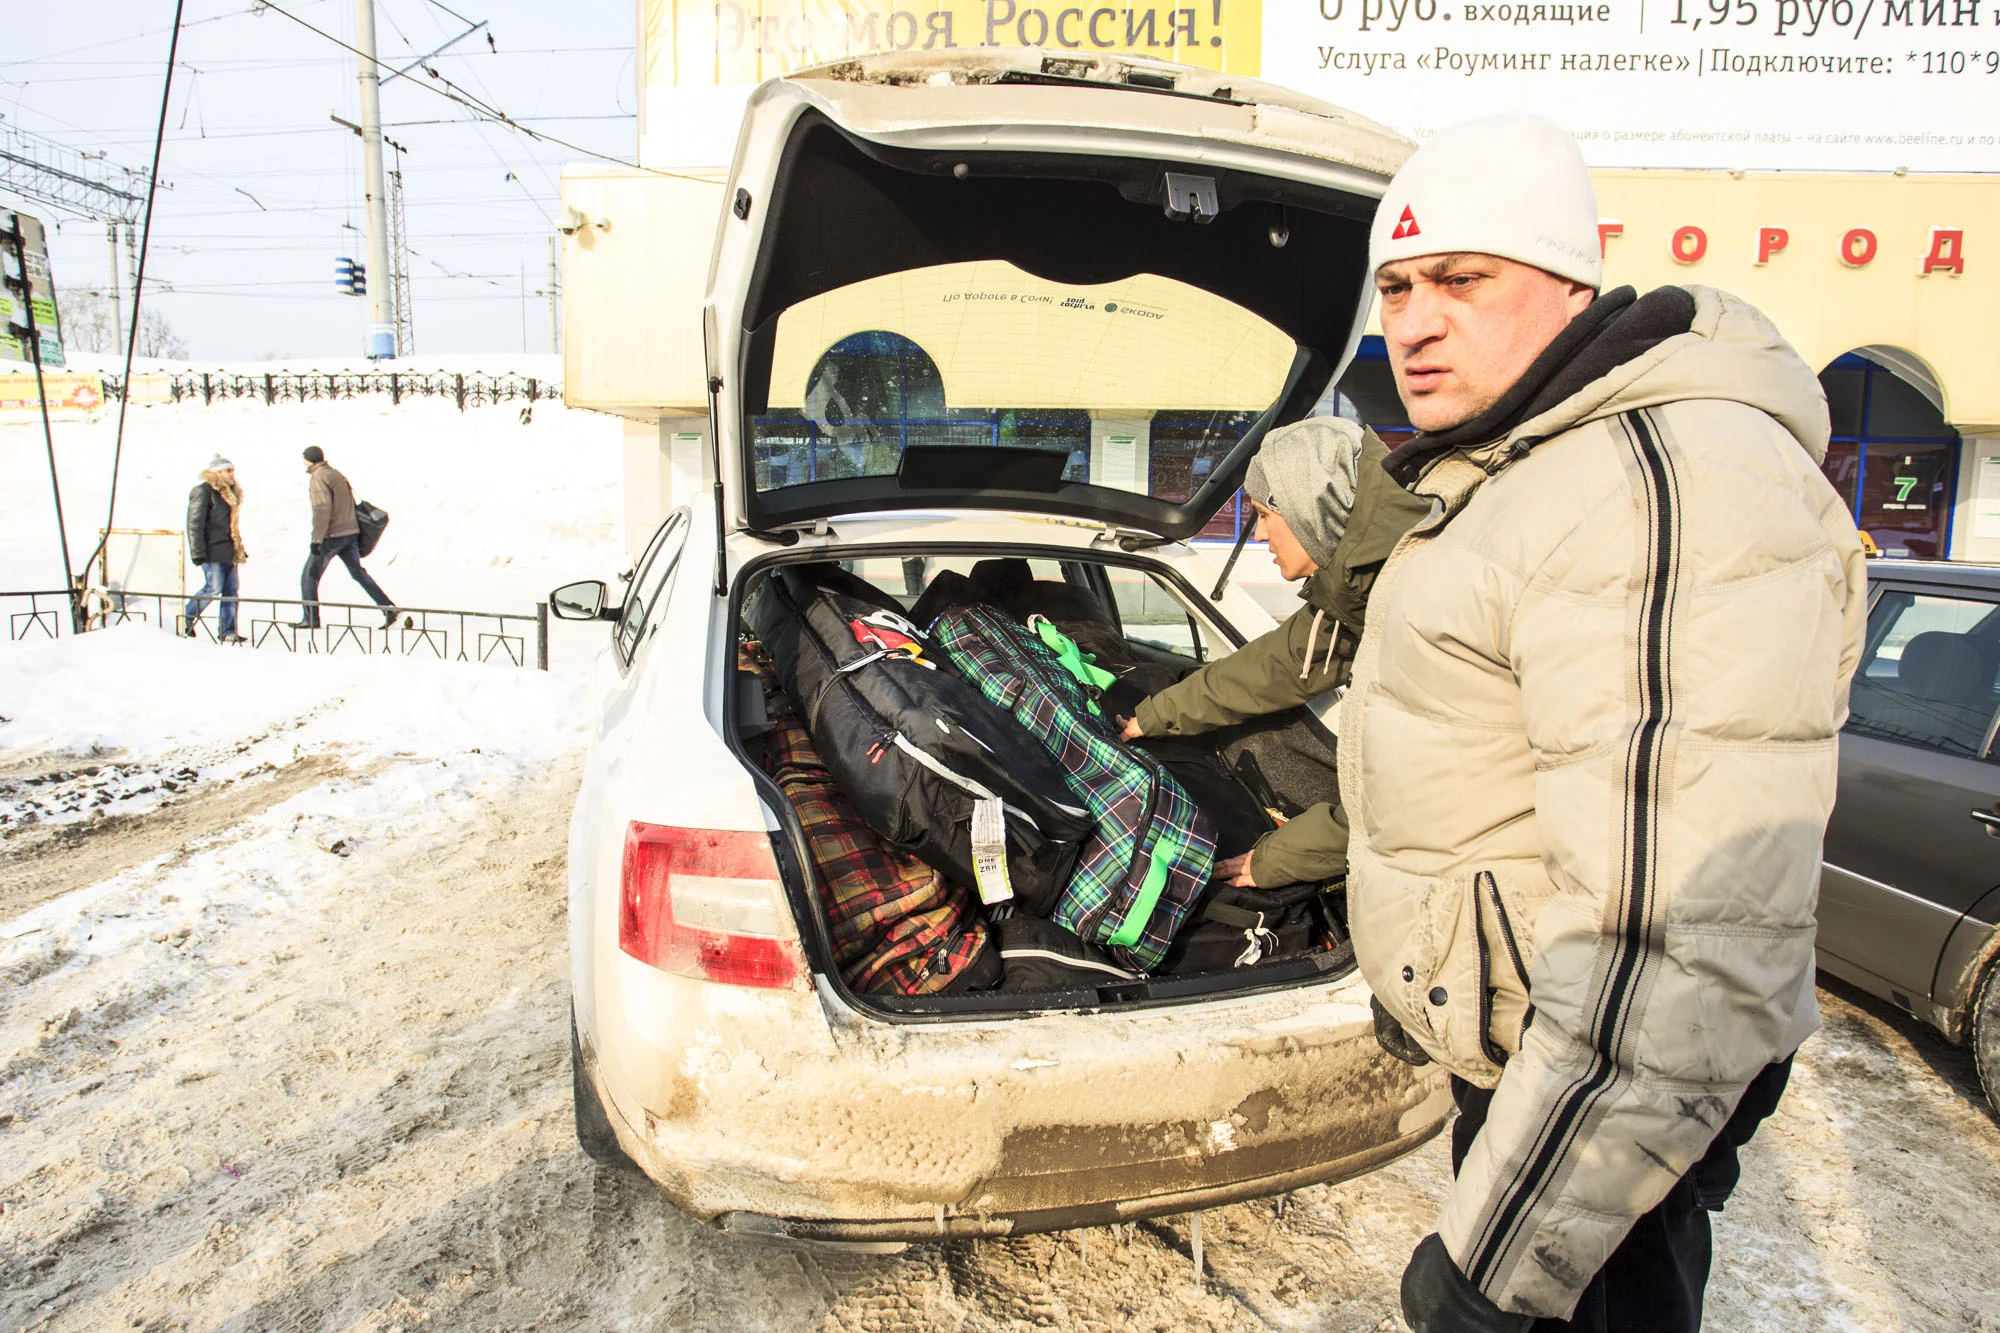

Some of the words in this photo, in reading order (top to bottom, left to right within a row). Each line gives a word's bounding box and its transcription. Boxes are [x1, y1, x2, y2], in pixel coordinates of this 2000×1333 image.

[715, 0, 814, 53] Это
[839, 11, 957, 51] моя
[980, 0, 1223, 47] Россия!
[1463, 3, 1611, 26] входящие
[1670, 0, 1758, 30] 1,95
[1773, 0, 1980, 40] руб/мин
[1317, 46, 1407, 77] Услуга
[1417, 46, 1552, 77] «Роуминг
[1560, 52, 1690, 72] налегке»
[1710, 48, 1893, 77] Подключите:
[1614, 131, 1666, 143] размере
[1669, 128, 1750, 143] абонентской
[1753, 132, 1791, 143] платы
[1825, 131, 1861, 144] сайте
[1864, 130, 1964, 145] www.beeline.ru
[1893, 476, 1918, 502] 7
[980, 864, 997, 873] ZRH
